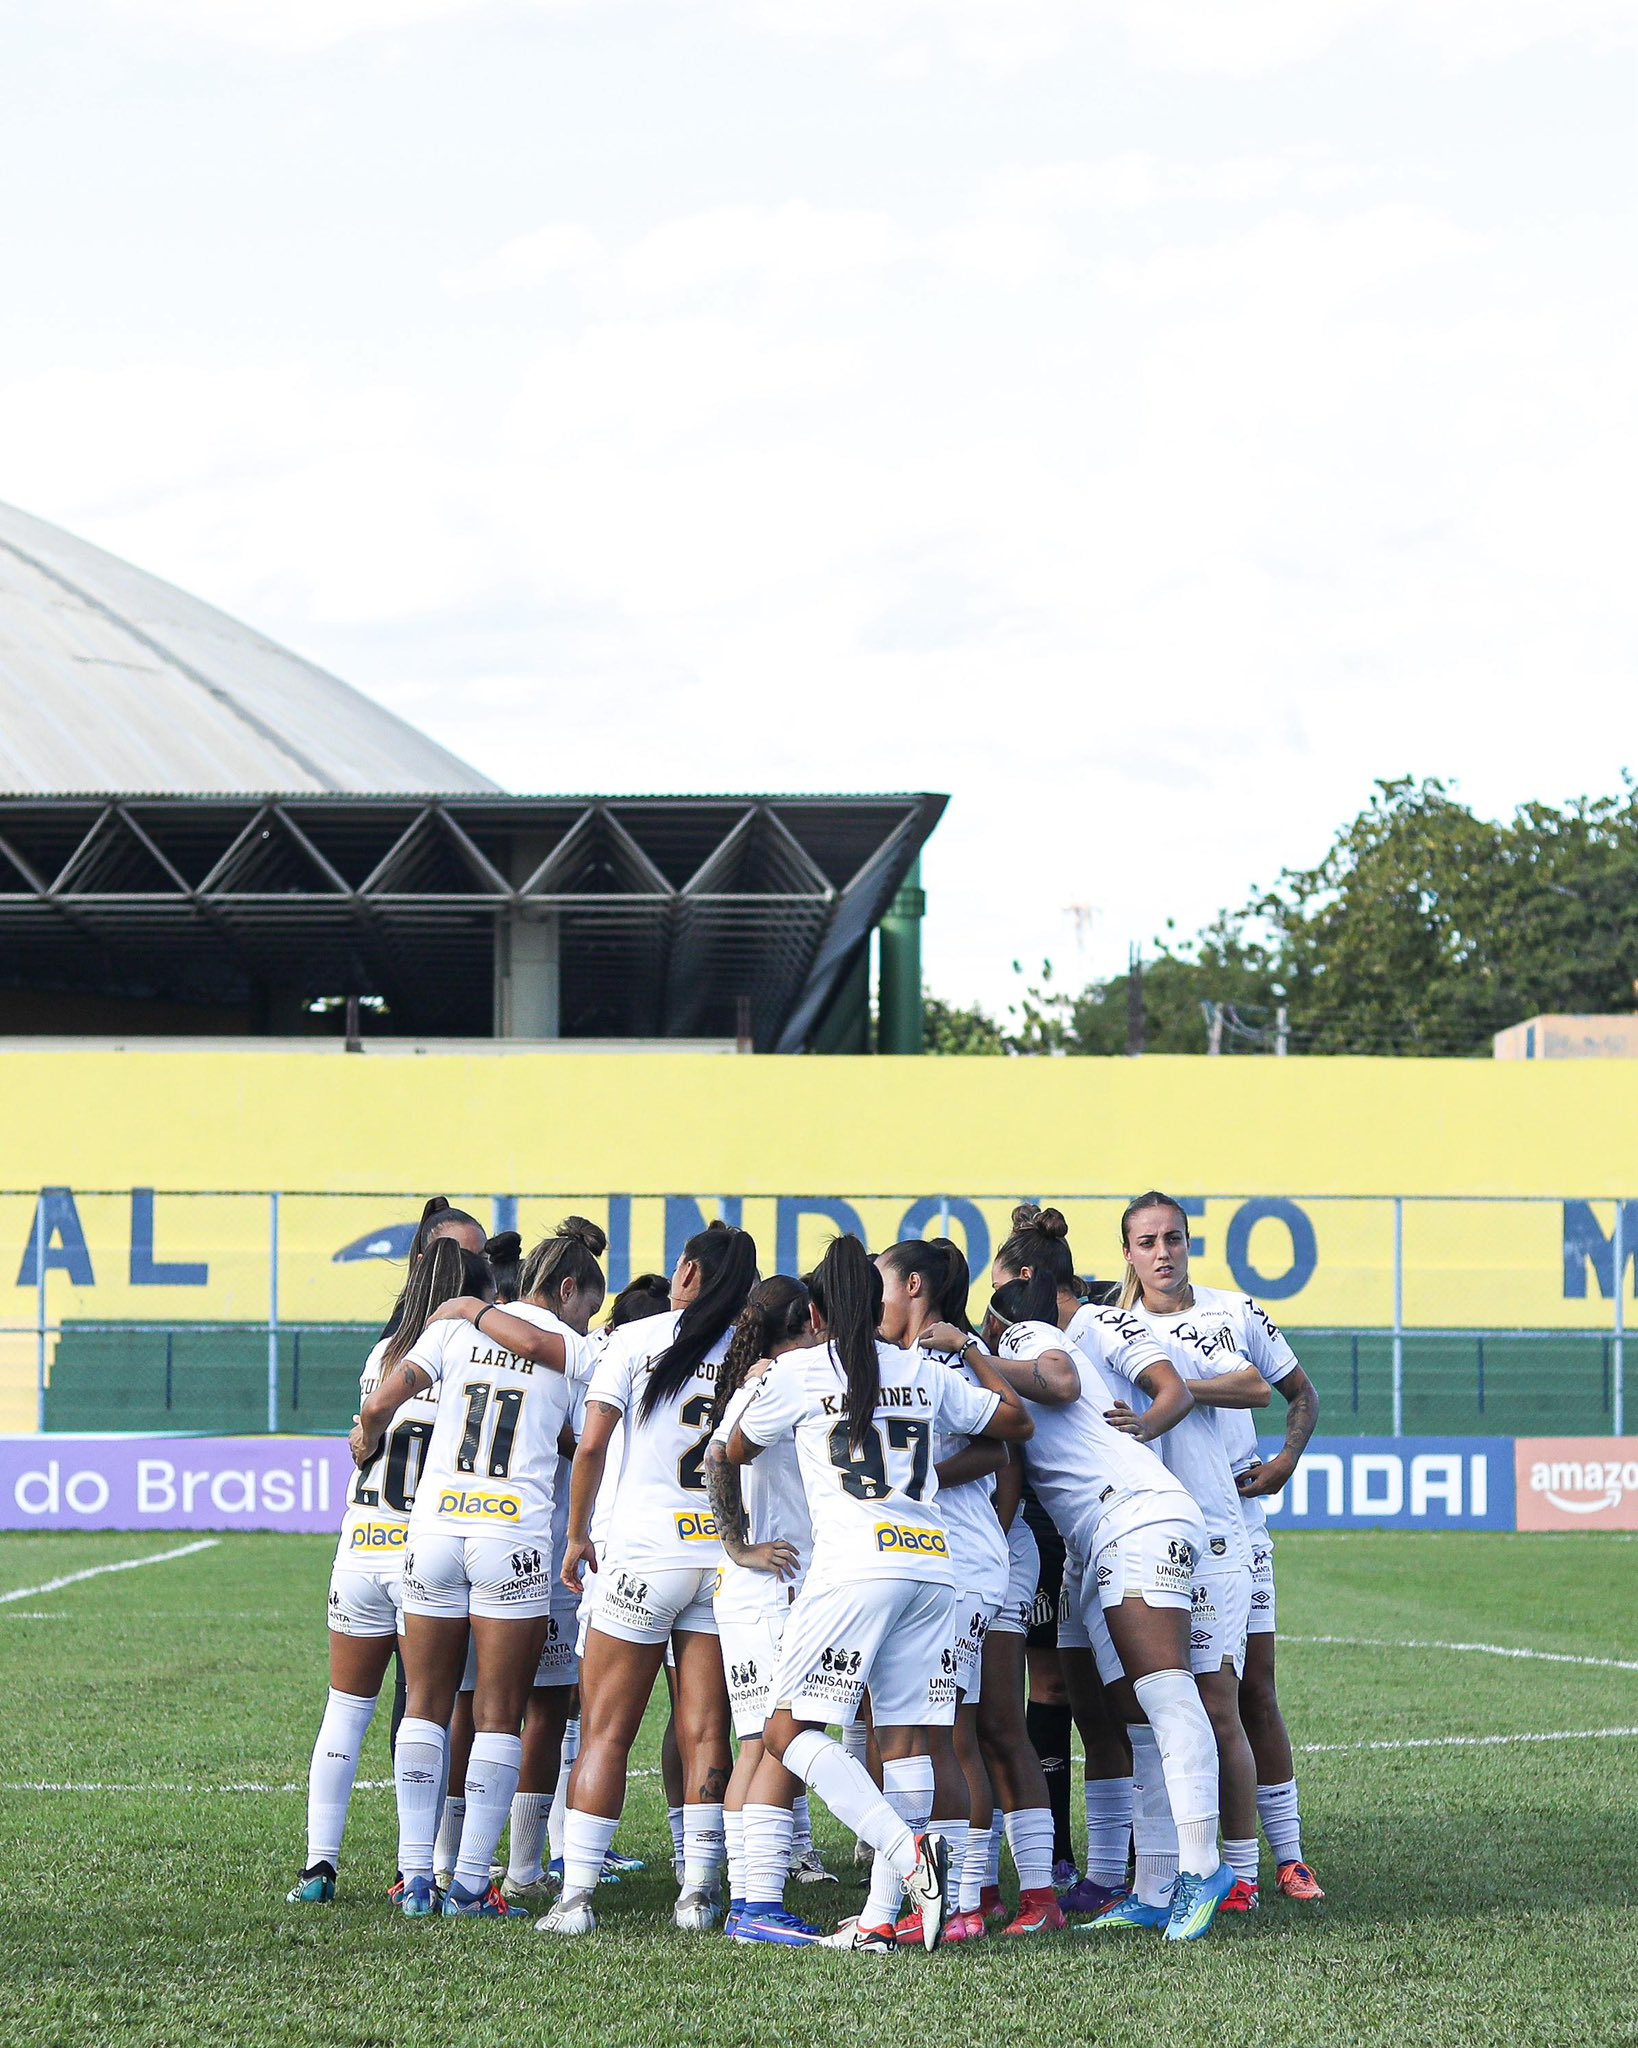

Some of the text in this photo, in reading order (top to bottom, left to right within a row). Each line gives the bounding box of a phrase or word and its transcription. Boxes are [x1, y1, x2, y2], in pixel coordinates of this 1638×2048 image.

[470, 1346, 535, 1375] LARYH
[917, 1387, 931, 1406] C.
[455, 1380, 528, 1480] 11
[826, 1417, 930, 1501] 97
[14, 1459, 329, 1514] do Brasil
[1265, 1454, 1488, 1516] NDAI
[438, 1493, 518, 1517] placo
[678, 1513, 718, 1539] pla
[878, 1526, 946, 1551] placo
[1156, 1565, 1190, 1580] UNISAN
[731, 1685, 770, 1702] NISANTA
[805, 1673, 866, 1692] UNISANTA
[929, 1678, 956, 1689] UNIS
[801, 1690, 830, 1700] SANTA
